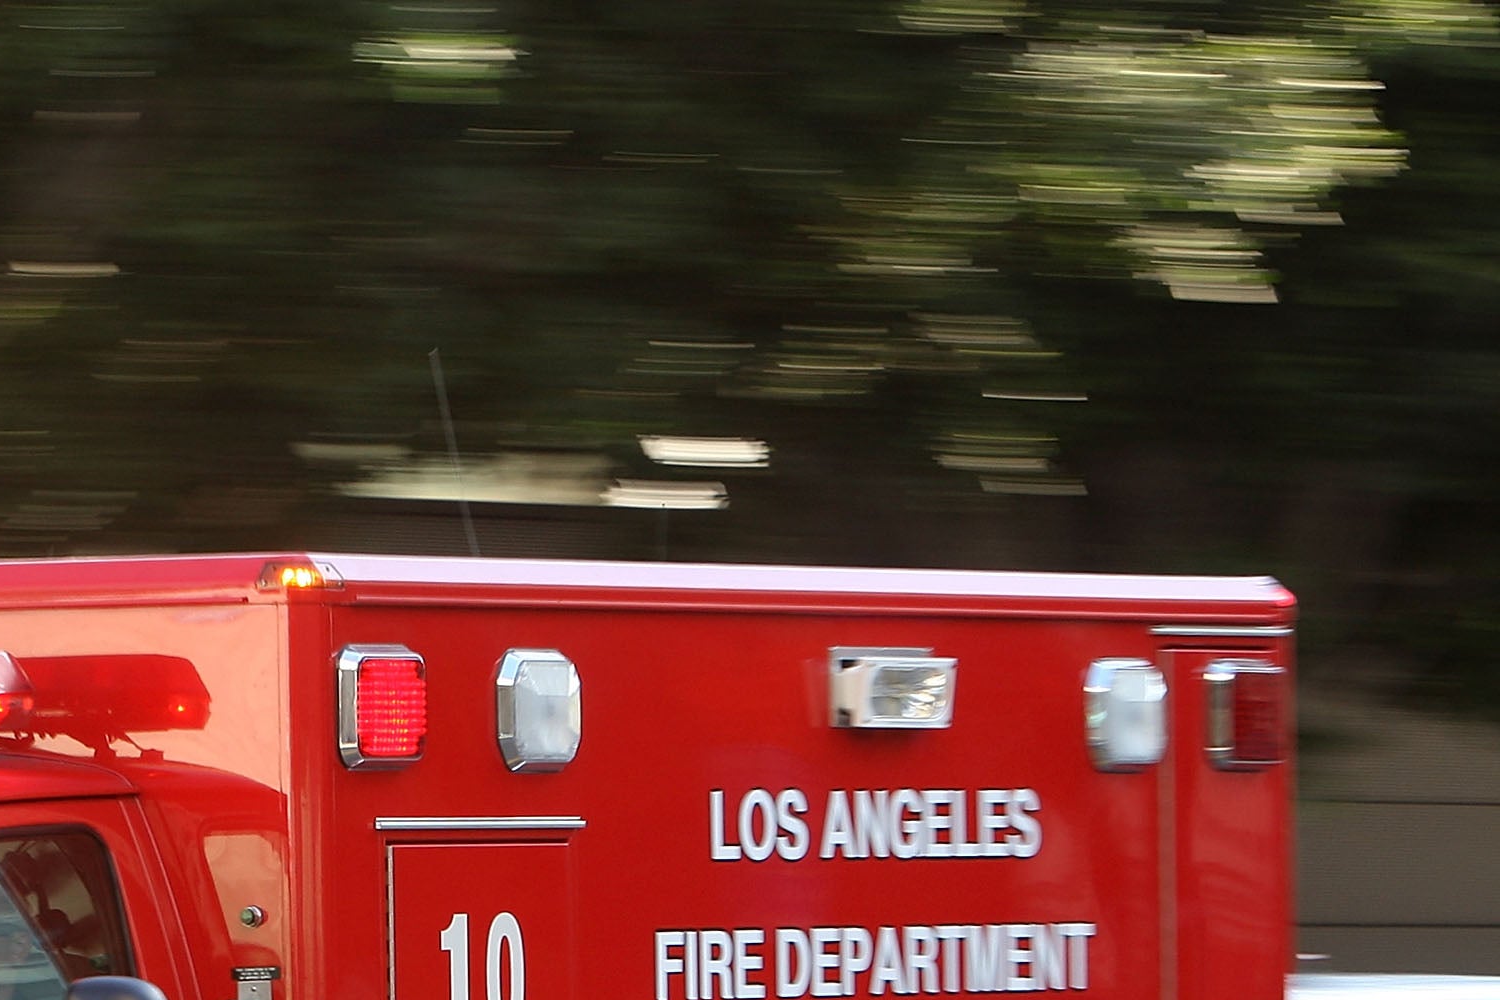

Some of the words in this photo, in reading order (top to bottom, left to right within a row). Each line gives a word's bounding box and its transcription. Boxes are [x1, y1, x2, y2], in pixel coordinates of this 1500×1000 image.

[709, 787, 811, 861] LOS
[819, 787, 1044, 860] ANGELES
[655, 929, 767, 1000] FIRE
[775, 922, 1098, 997] DEPARTMENT
